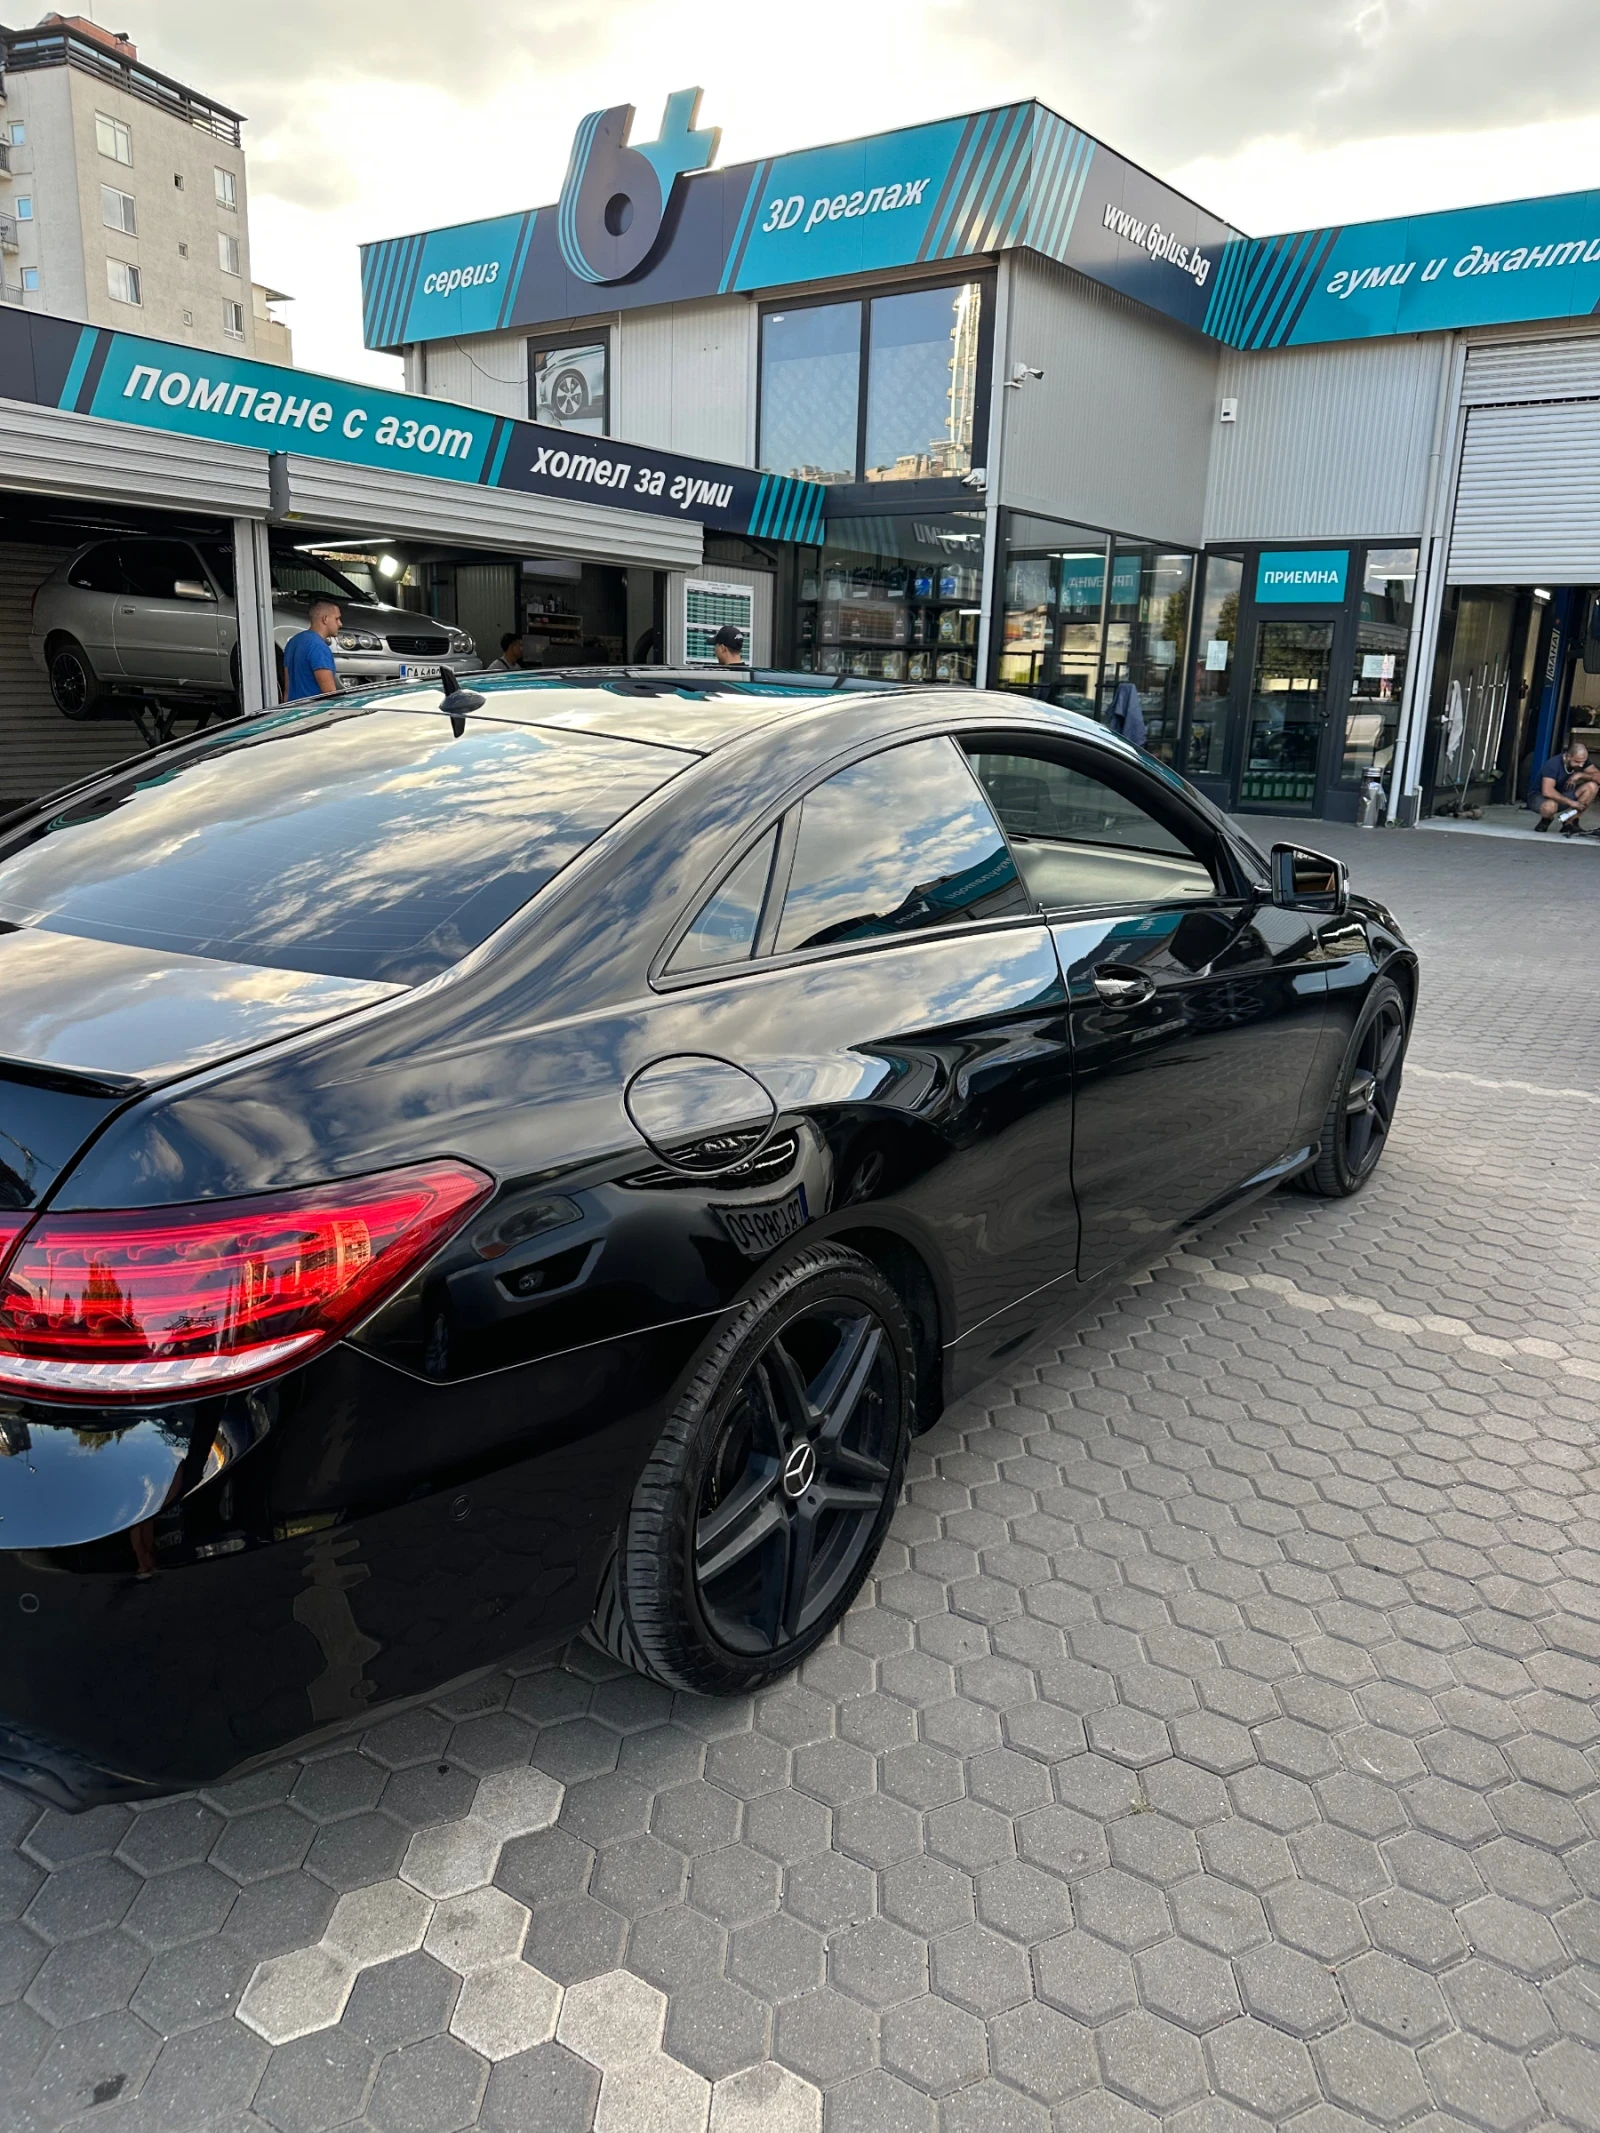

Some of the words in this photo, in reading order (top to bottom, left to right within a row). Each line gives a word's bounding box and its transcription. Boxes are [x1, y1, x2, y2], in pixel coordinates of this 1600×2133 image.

[761, 193, 804, 233] 3D
[803, 174, 932, 232] реглаж
[1102, 202, 1211, 287] www.6plus.bg
[423, 260, 499, 295] сервиз
[1326, 261, 1415, 300] гуми
[1420, 256, 1450, 283] и
[123, 364, 333, 433] помпане
[345, 408, 368, 439] с
[375, 415, 474, 459] азот
[530, 445, 632, 488] хотел
[634, 465, 667, 496] за
[668, 476, 733, 510] гуми
[1264, 570, 1339, 584] ПРИЕМНА
[1547, 636, 1559, 676] MAHA
